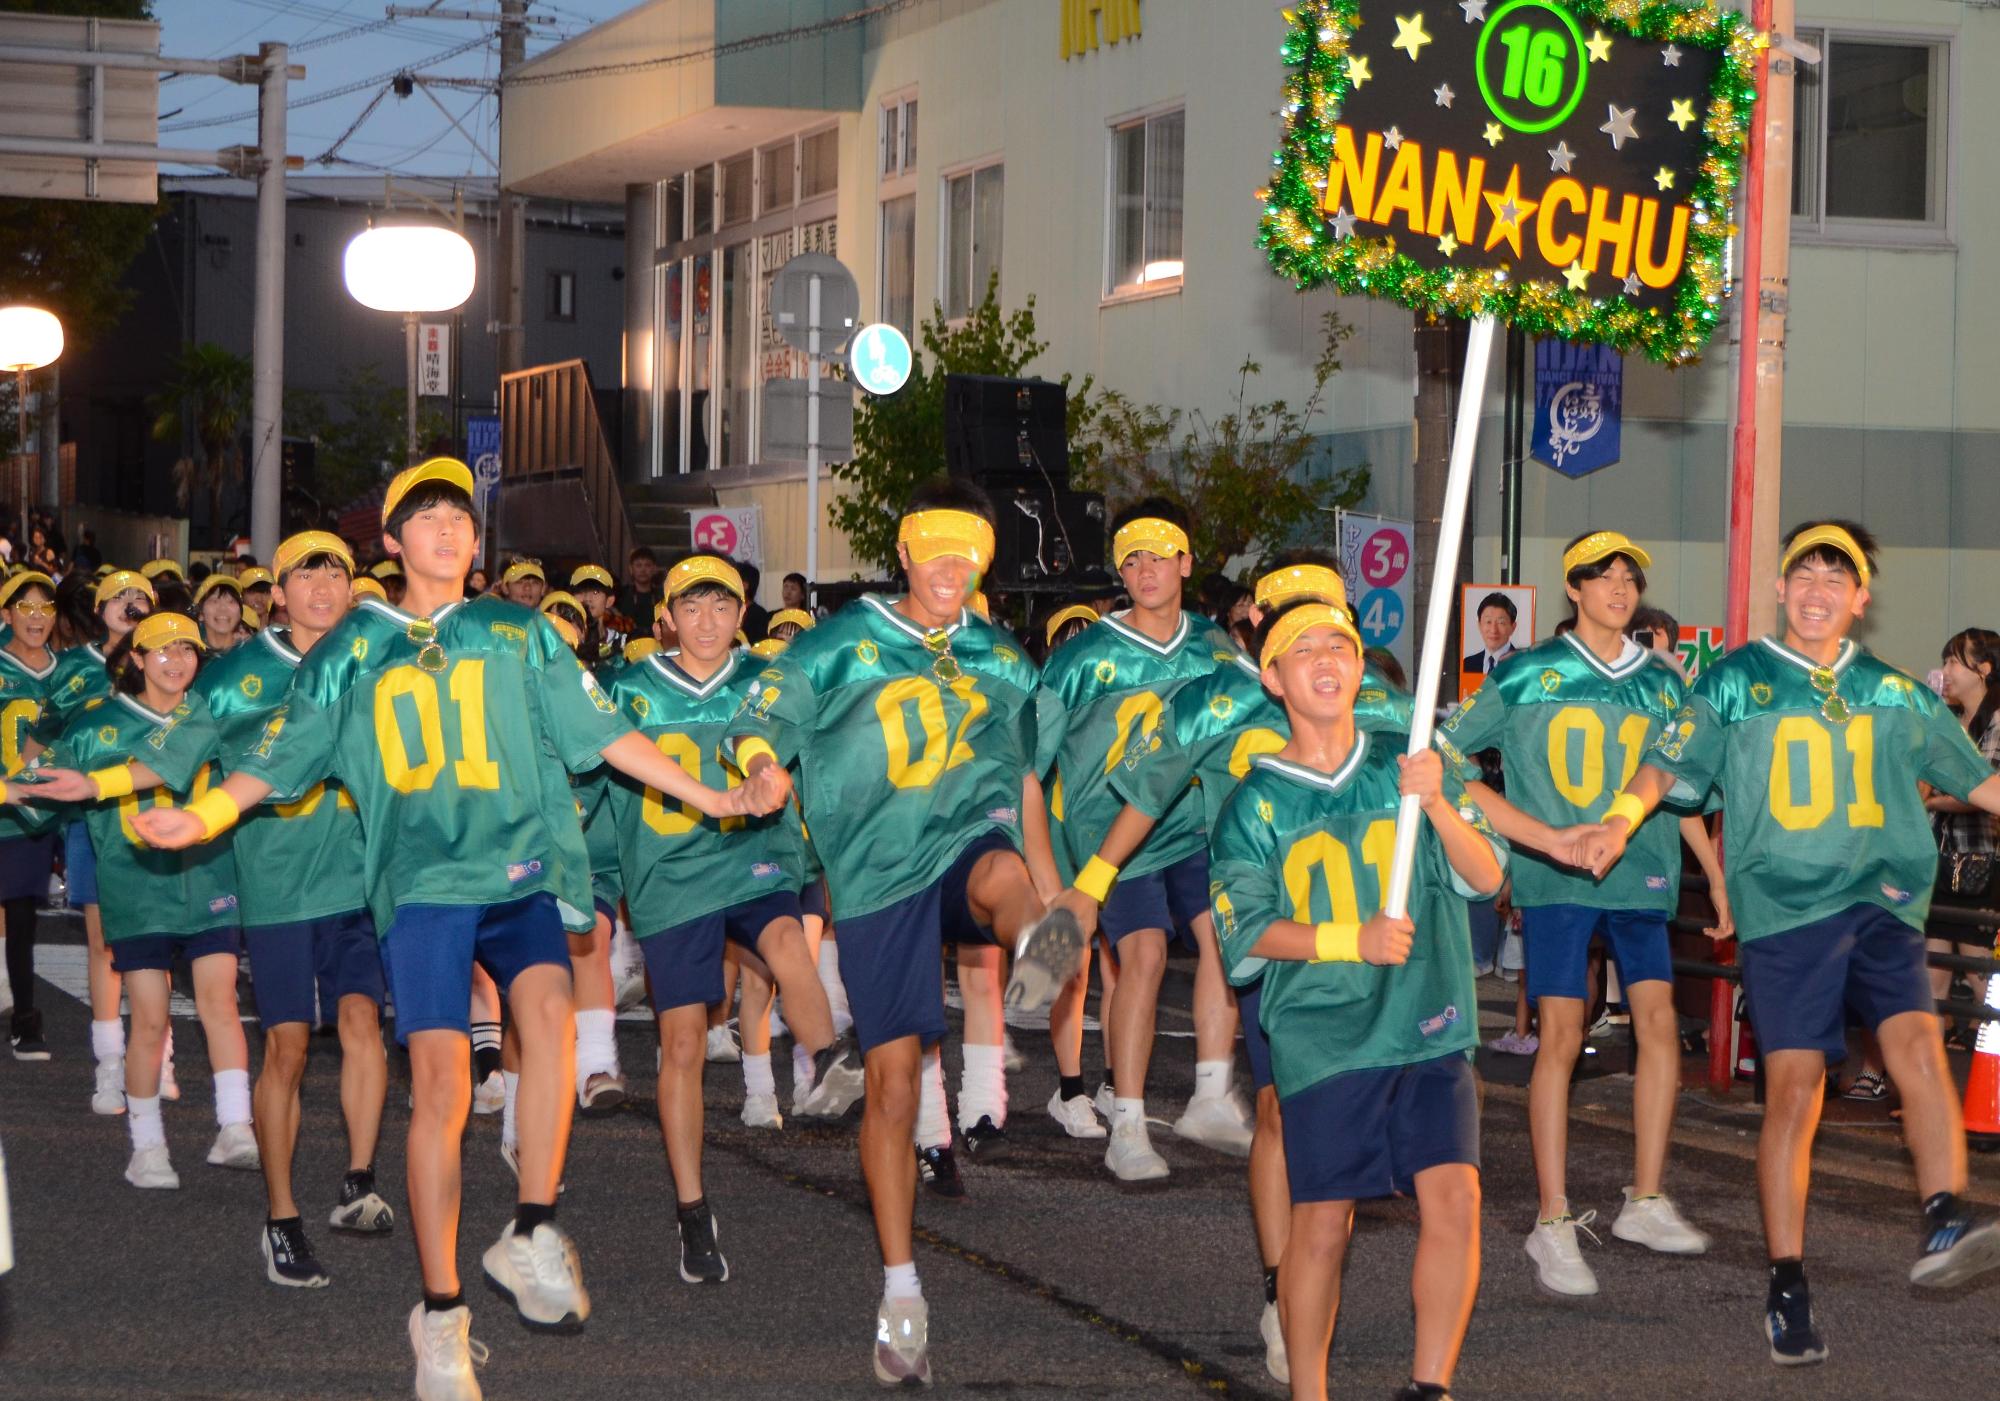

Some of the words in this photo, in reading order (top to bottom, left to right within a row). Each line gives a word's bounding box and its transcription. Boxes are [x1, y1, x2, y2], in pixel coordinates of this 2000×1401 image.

[1499, 25, 1568, 107] 16
[374, 659, 500, 795] 01
[1548, 706, 1650, 809] 01
[1769, 714, 1885, 831] 01
[1282, 819, 1397, 965] 01
